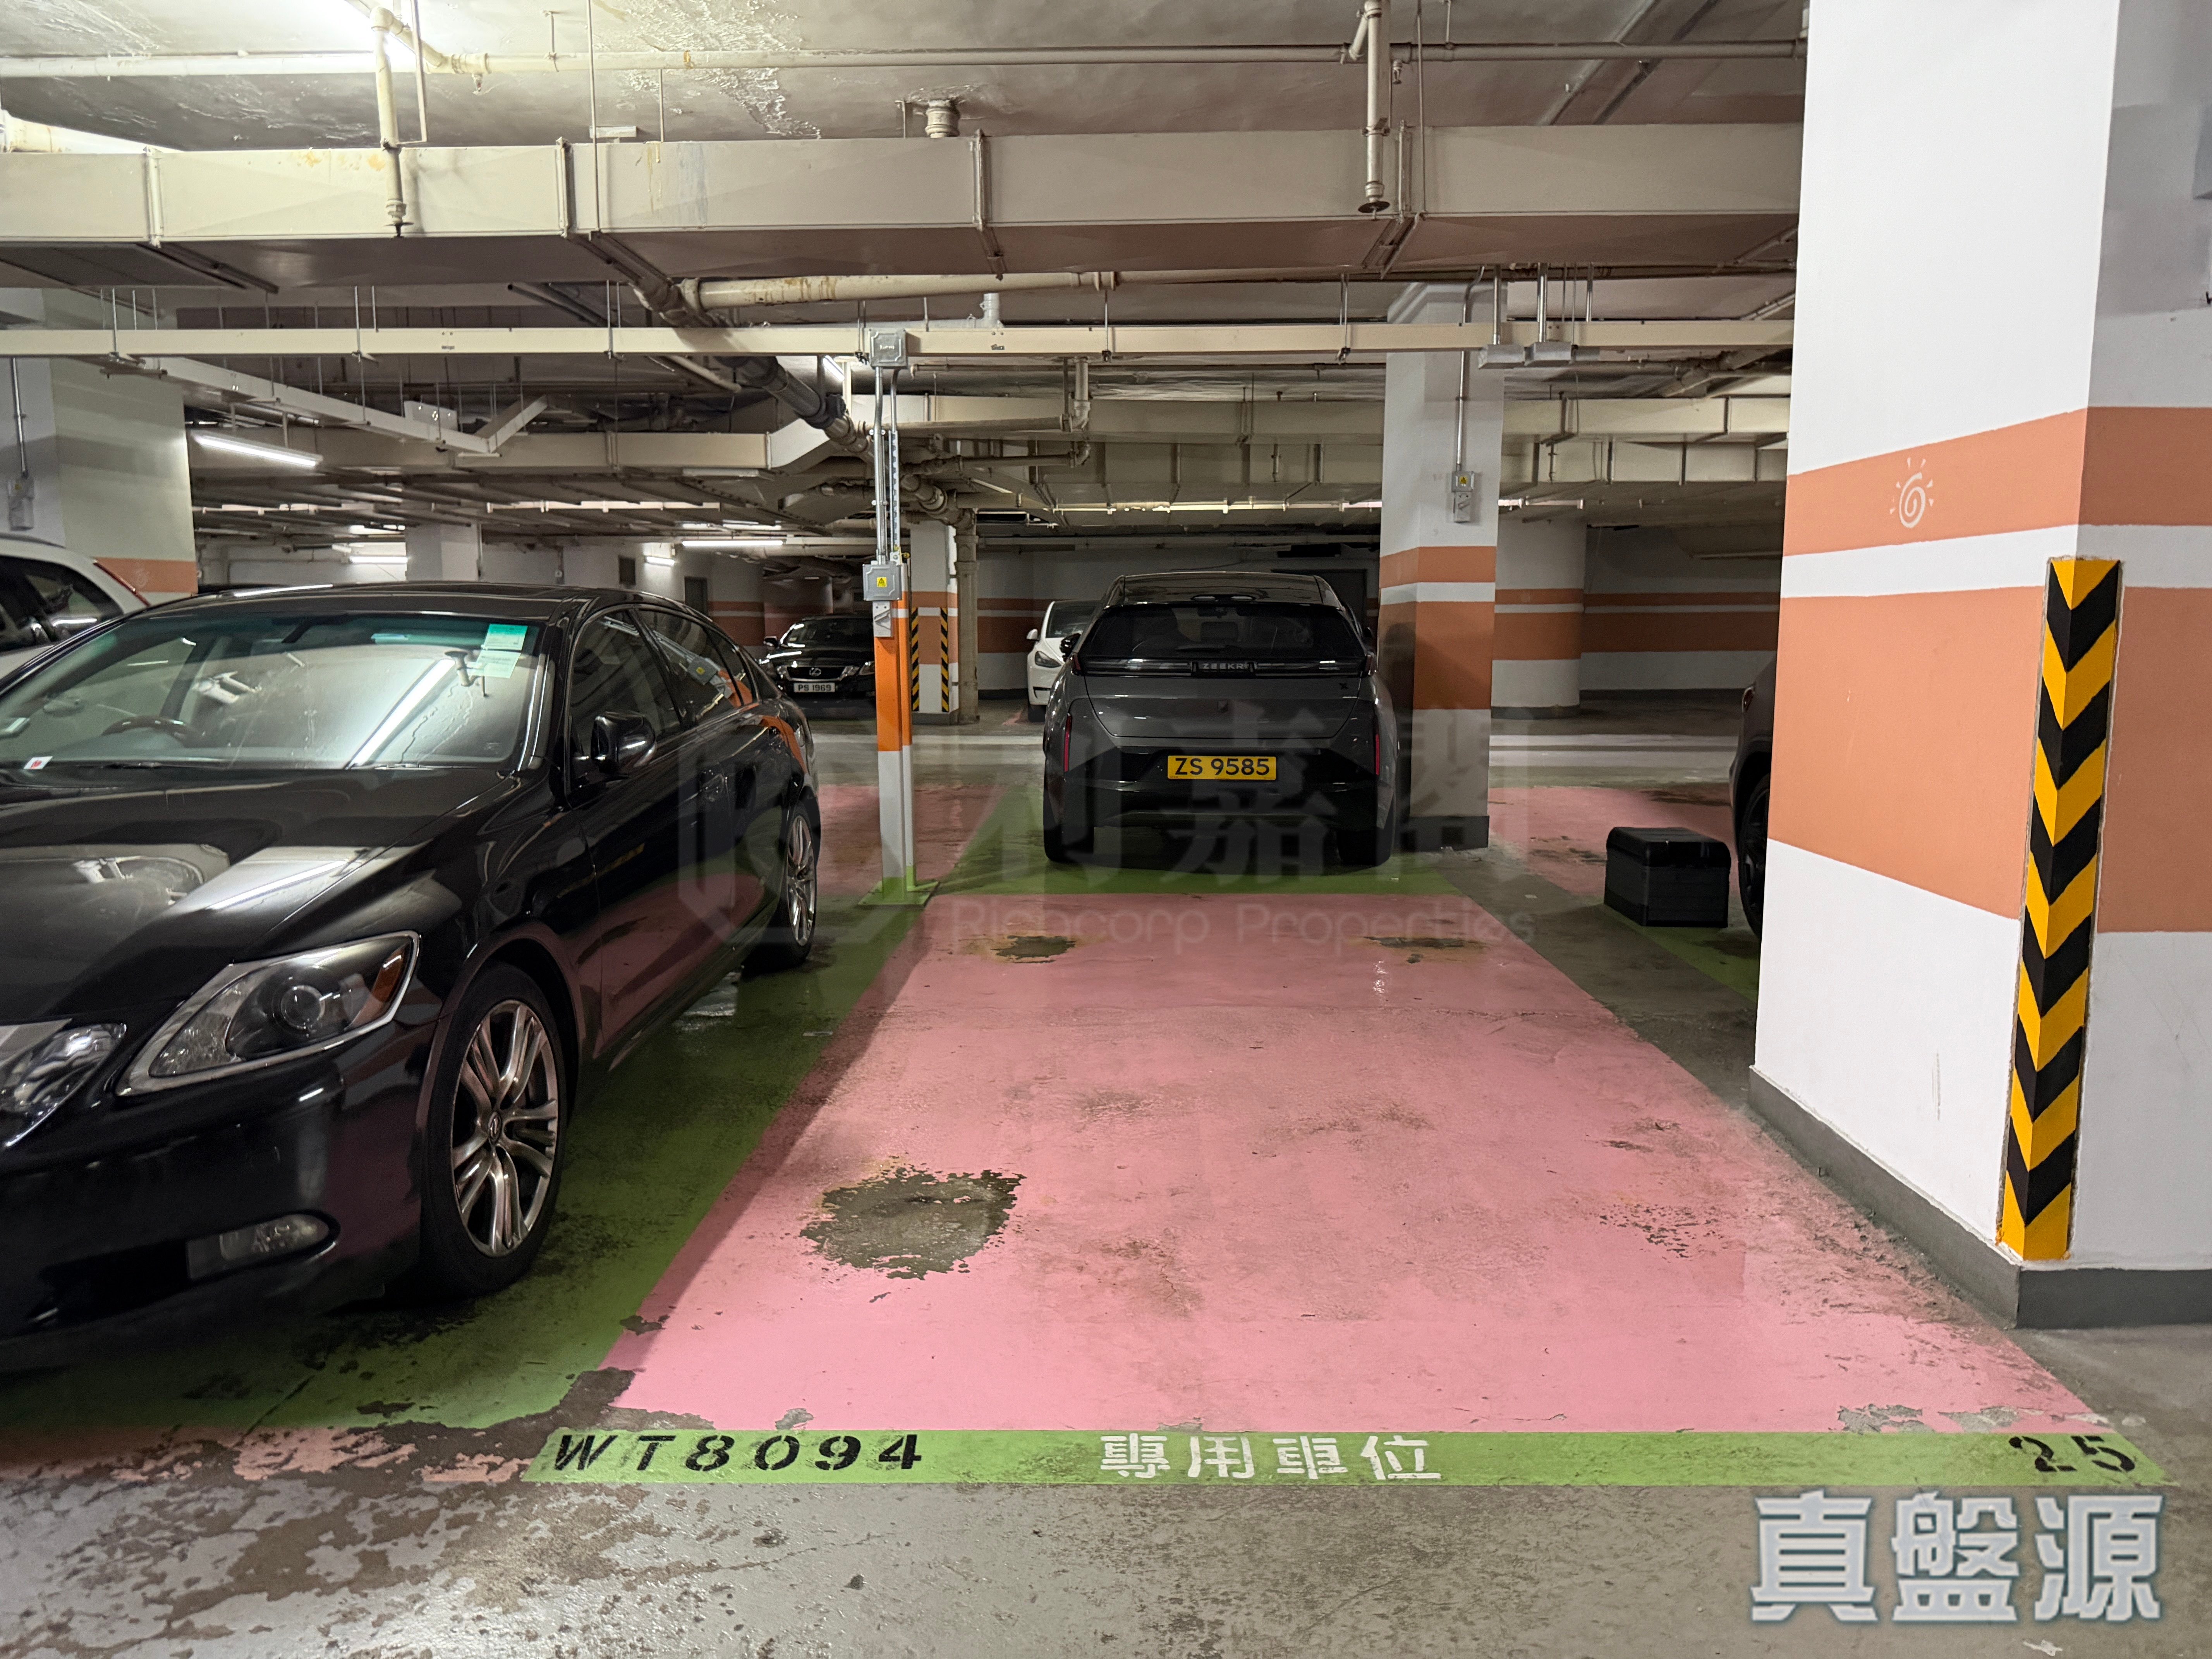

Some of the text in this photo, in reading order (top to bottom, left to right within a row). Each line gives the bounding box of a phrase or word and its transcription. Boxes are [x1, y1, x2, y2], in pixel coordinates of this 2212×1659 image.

[1175, 758, 1269, 775] ZS 9585
[554, 1434, 922, 1471] WT8094
[1100, 1433, 1441, 1480] 專用車位
[2008, 1435, 2136, 1472] 25
